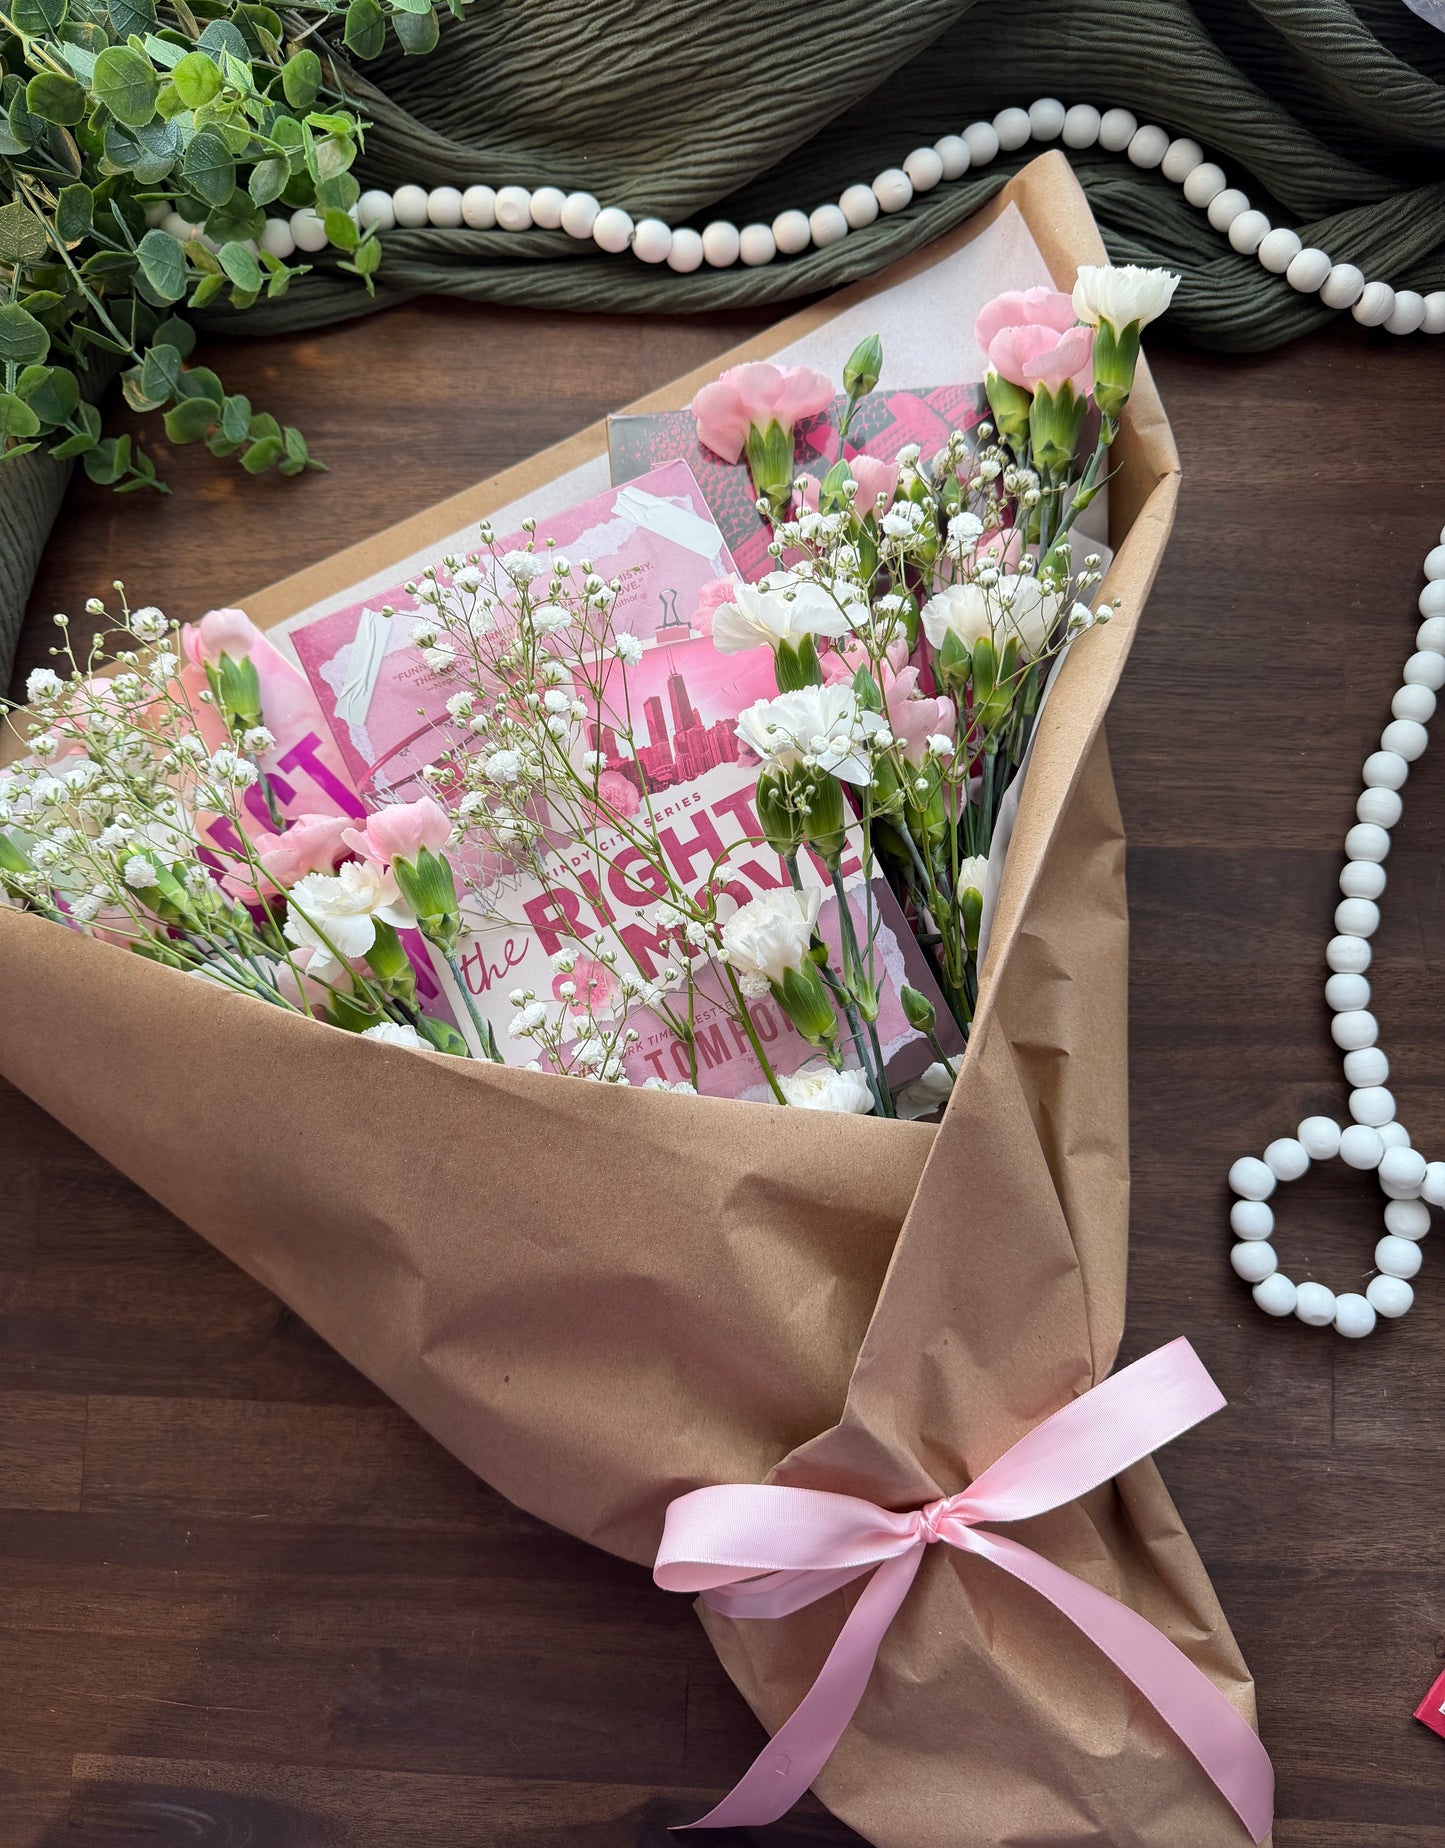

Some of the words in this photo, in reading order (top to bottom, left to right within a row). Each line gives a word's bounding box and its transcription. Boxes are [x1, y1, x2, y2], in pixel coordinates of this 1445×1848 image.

[611, 593, 638, 609] uthor
[441, 657, 470, 677] OOK
[599, 827, 636, 852] CITY
[643, 791, 702, 828] SERIES
[523, 780, 770, 957] RIGHT
[459, 936, 530, 995] the
[647, 1026, 677, 1046] TIME
